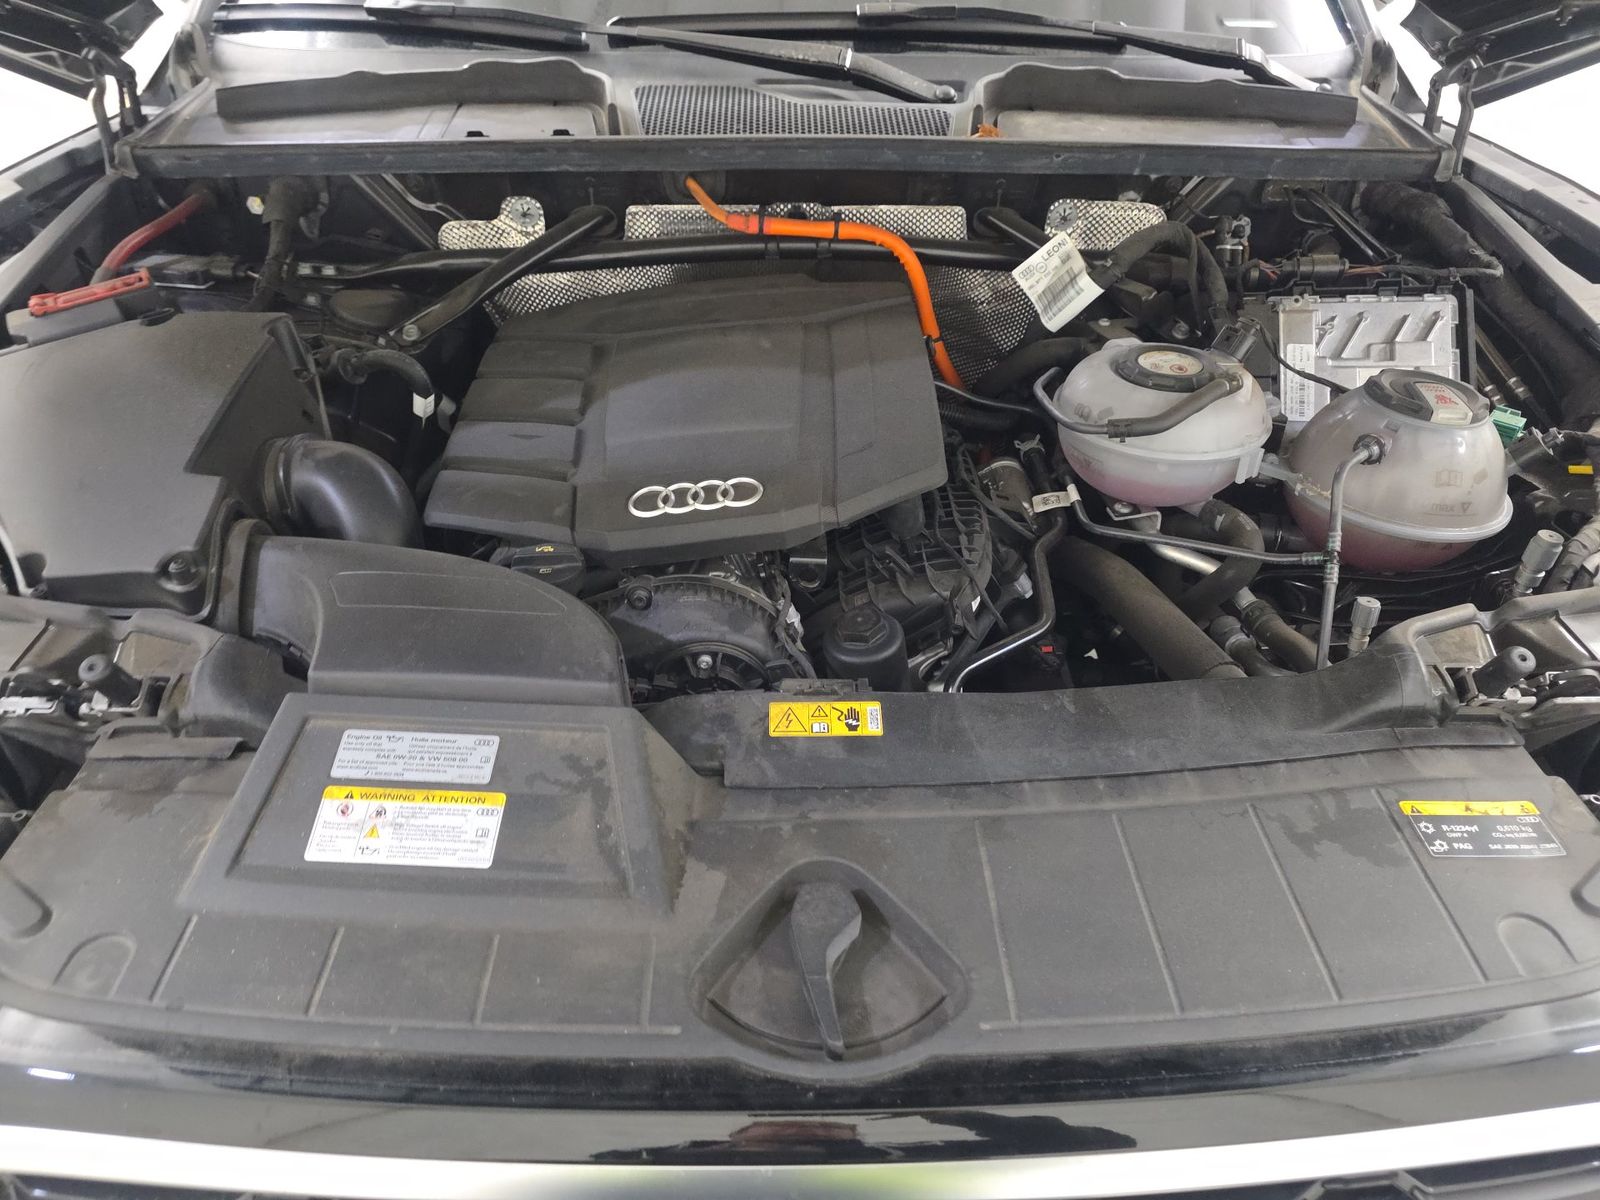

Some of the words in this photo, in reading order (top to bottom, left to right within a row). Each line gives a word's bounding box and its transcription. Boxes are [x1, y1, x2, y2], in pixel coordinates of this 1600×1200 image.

[1041, 238, 1069, 262] LEONI
[359, 792, 415, 801] WARNING
[421, 794, 486, 804] ATTENTION
[1519, 825, 1533, 833] kg
